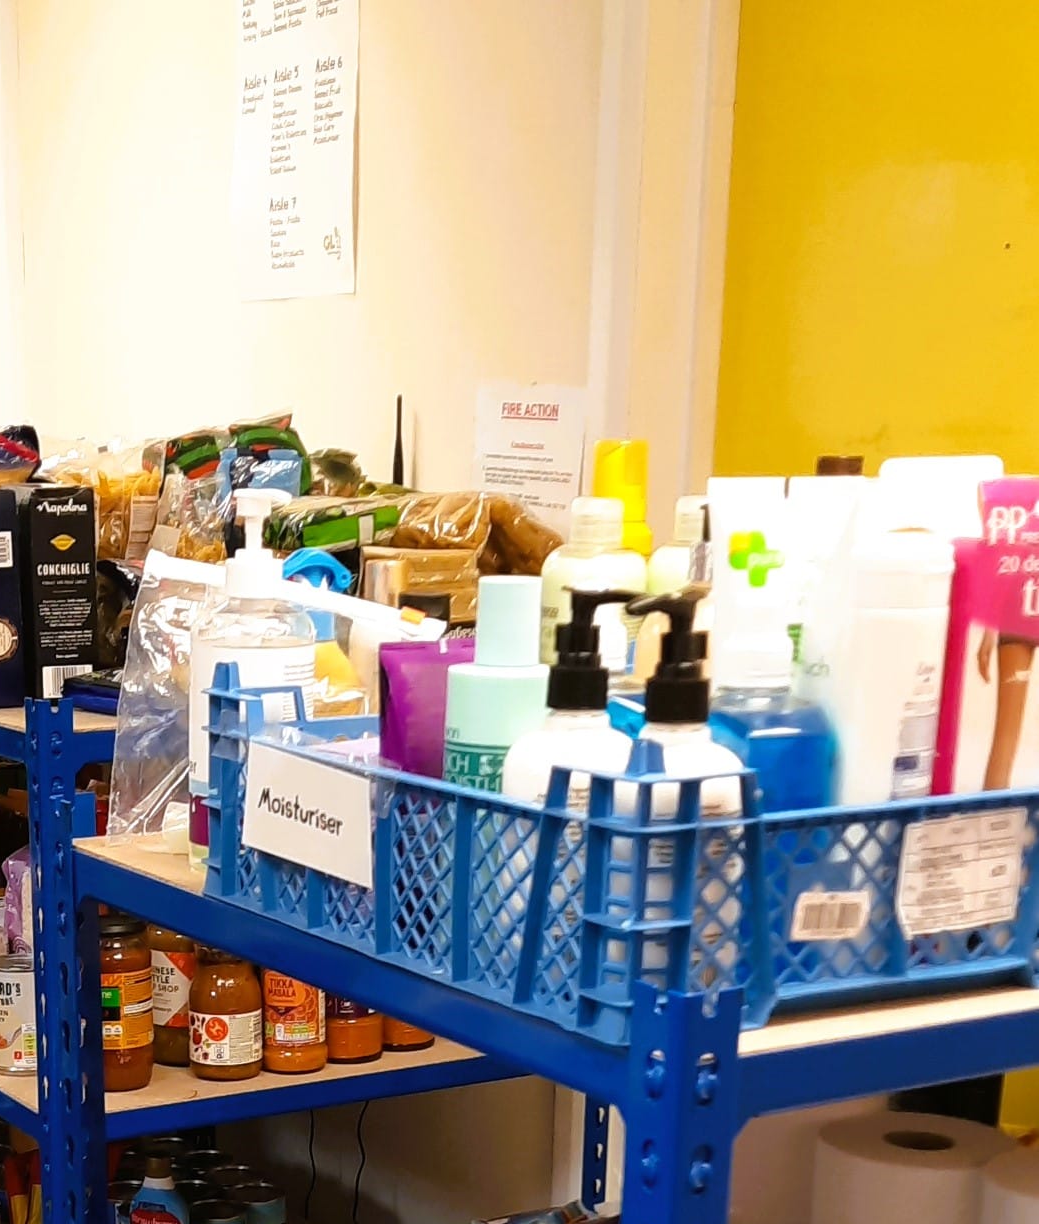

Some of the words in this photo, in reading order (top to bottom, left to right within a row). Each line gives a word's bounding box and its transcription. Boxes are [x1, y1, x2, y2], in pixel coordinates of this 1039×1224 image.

[315, 56, 335, 72] Aisle
[337, 56, 343, 69] 6
[274, 66, 292, 83] Aisle
[294, 65, 299, 79] 5
[244, 74, 261, 91] Aisle
[269, 197, 289, 213] Aisle
[502, 402, 522, 416] FIRE
[524, 403, 560, 417] ACTION
[36, 498, 88, 516] Napolina
[37, 562, 91, 577] CONCHIGLIE
[998, 555, 1020, 575] 20
[258, 787, 343, 836] Moisturiser
[159, 984, 179, 993] SHOP
[269, 978, 294, 989] TIKKA
[267, 988, 296, 998] MASALA
